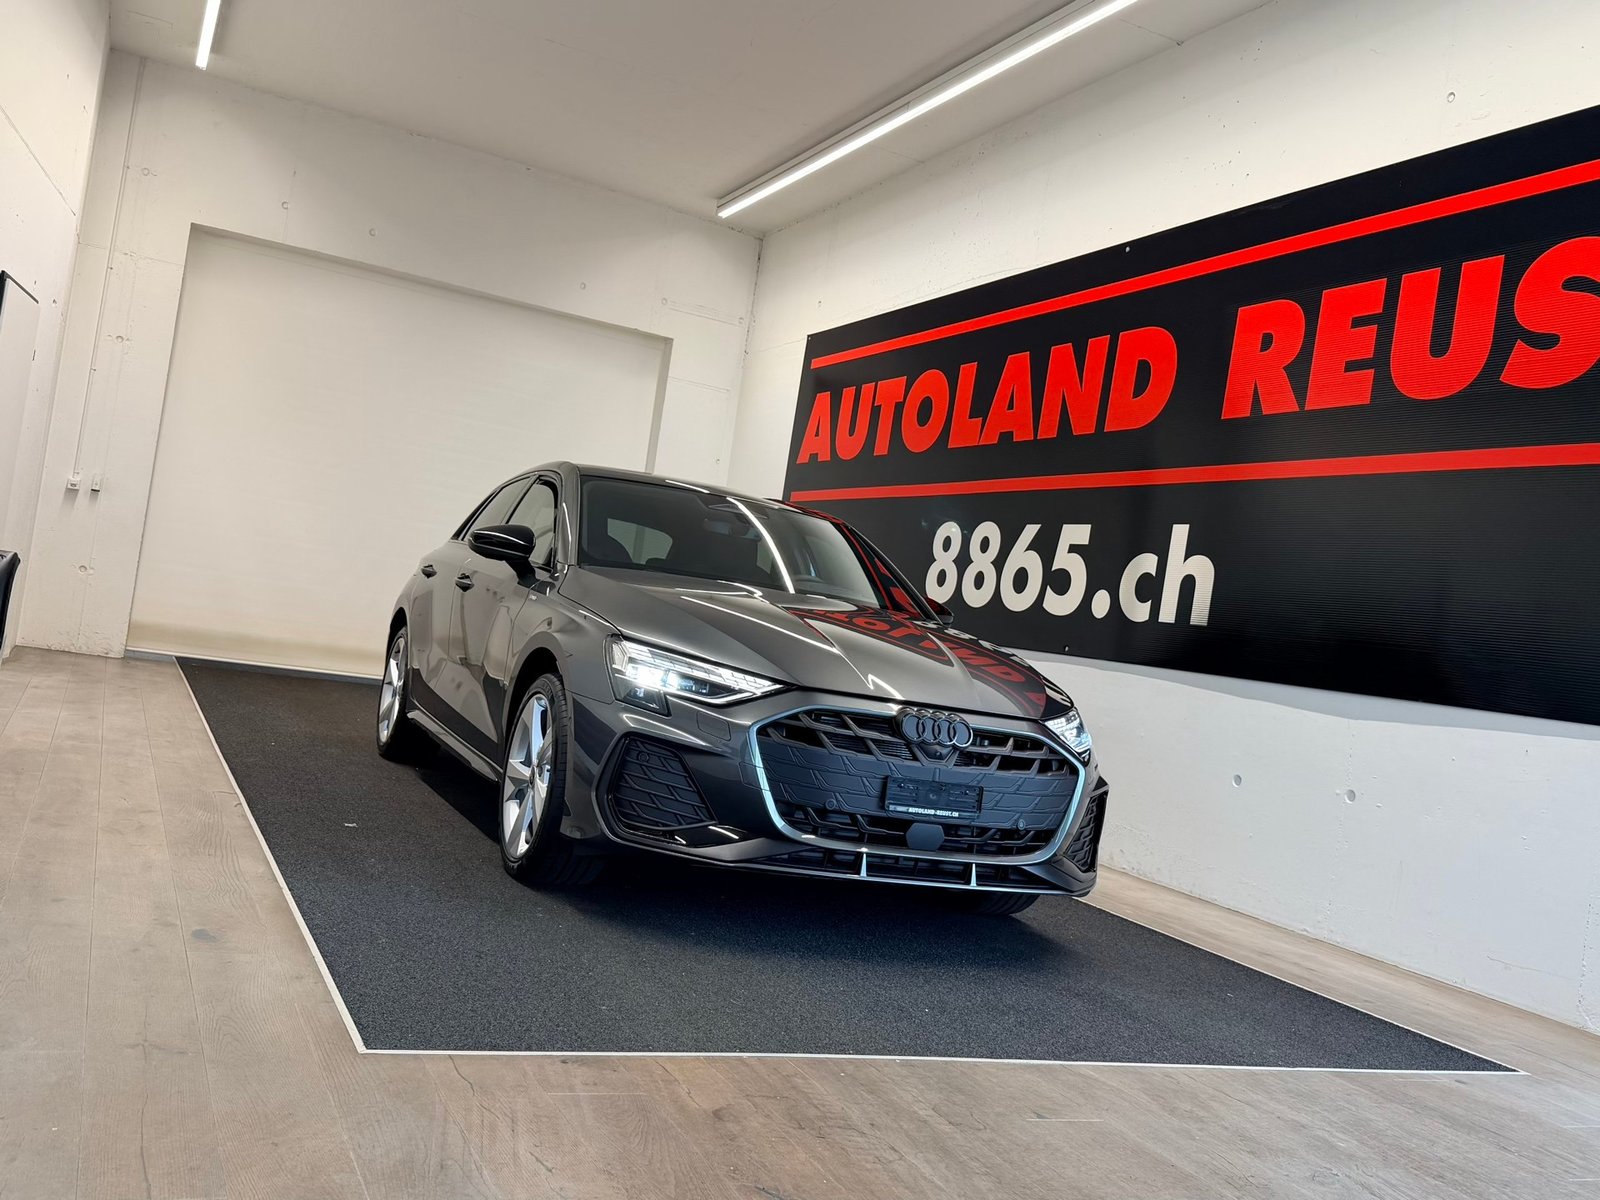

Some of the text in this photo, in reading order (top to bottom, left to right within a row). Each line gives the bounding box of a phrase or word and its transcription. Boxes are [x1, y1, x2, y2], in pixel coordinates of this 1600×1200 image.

[798, 236, 1600, 464] AUTOLAND REUS
[926, 521, 1215, 626] 8865.ch
